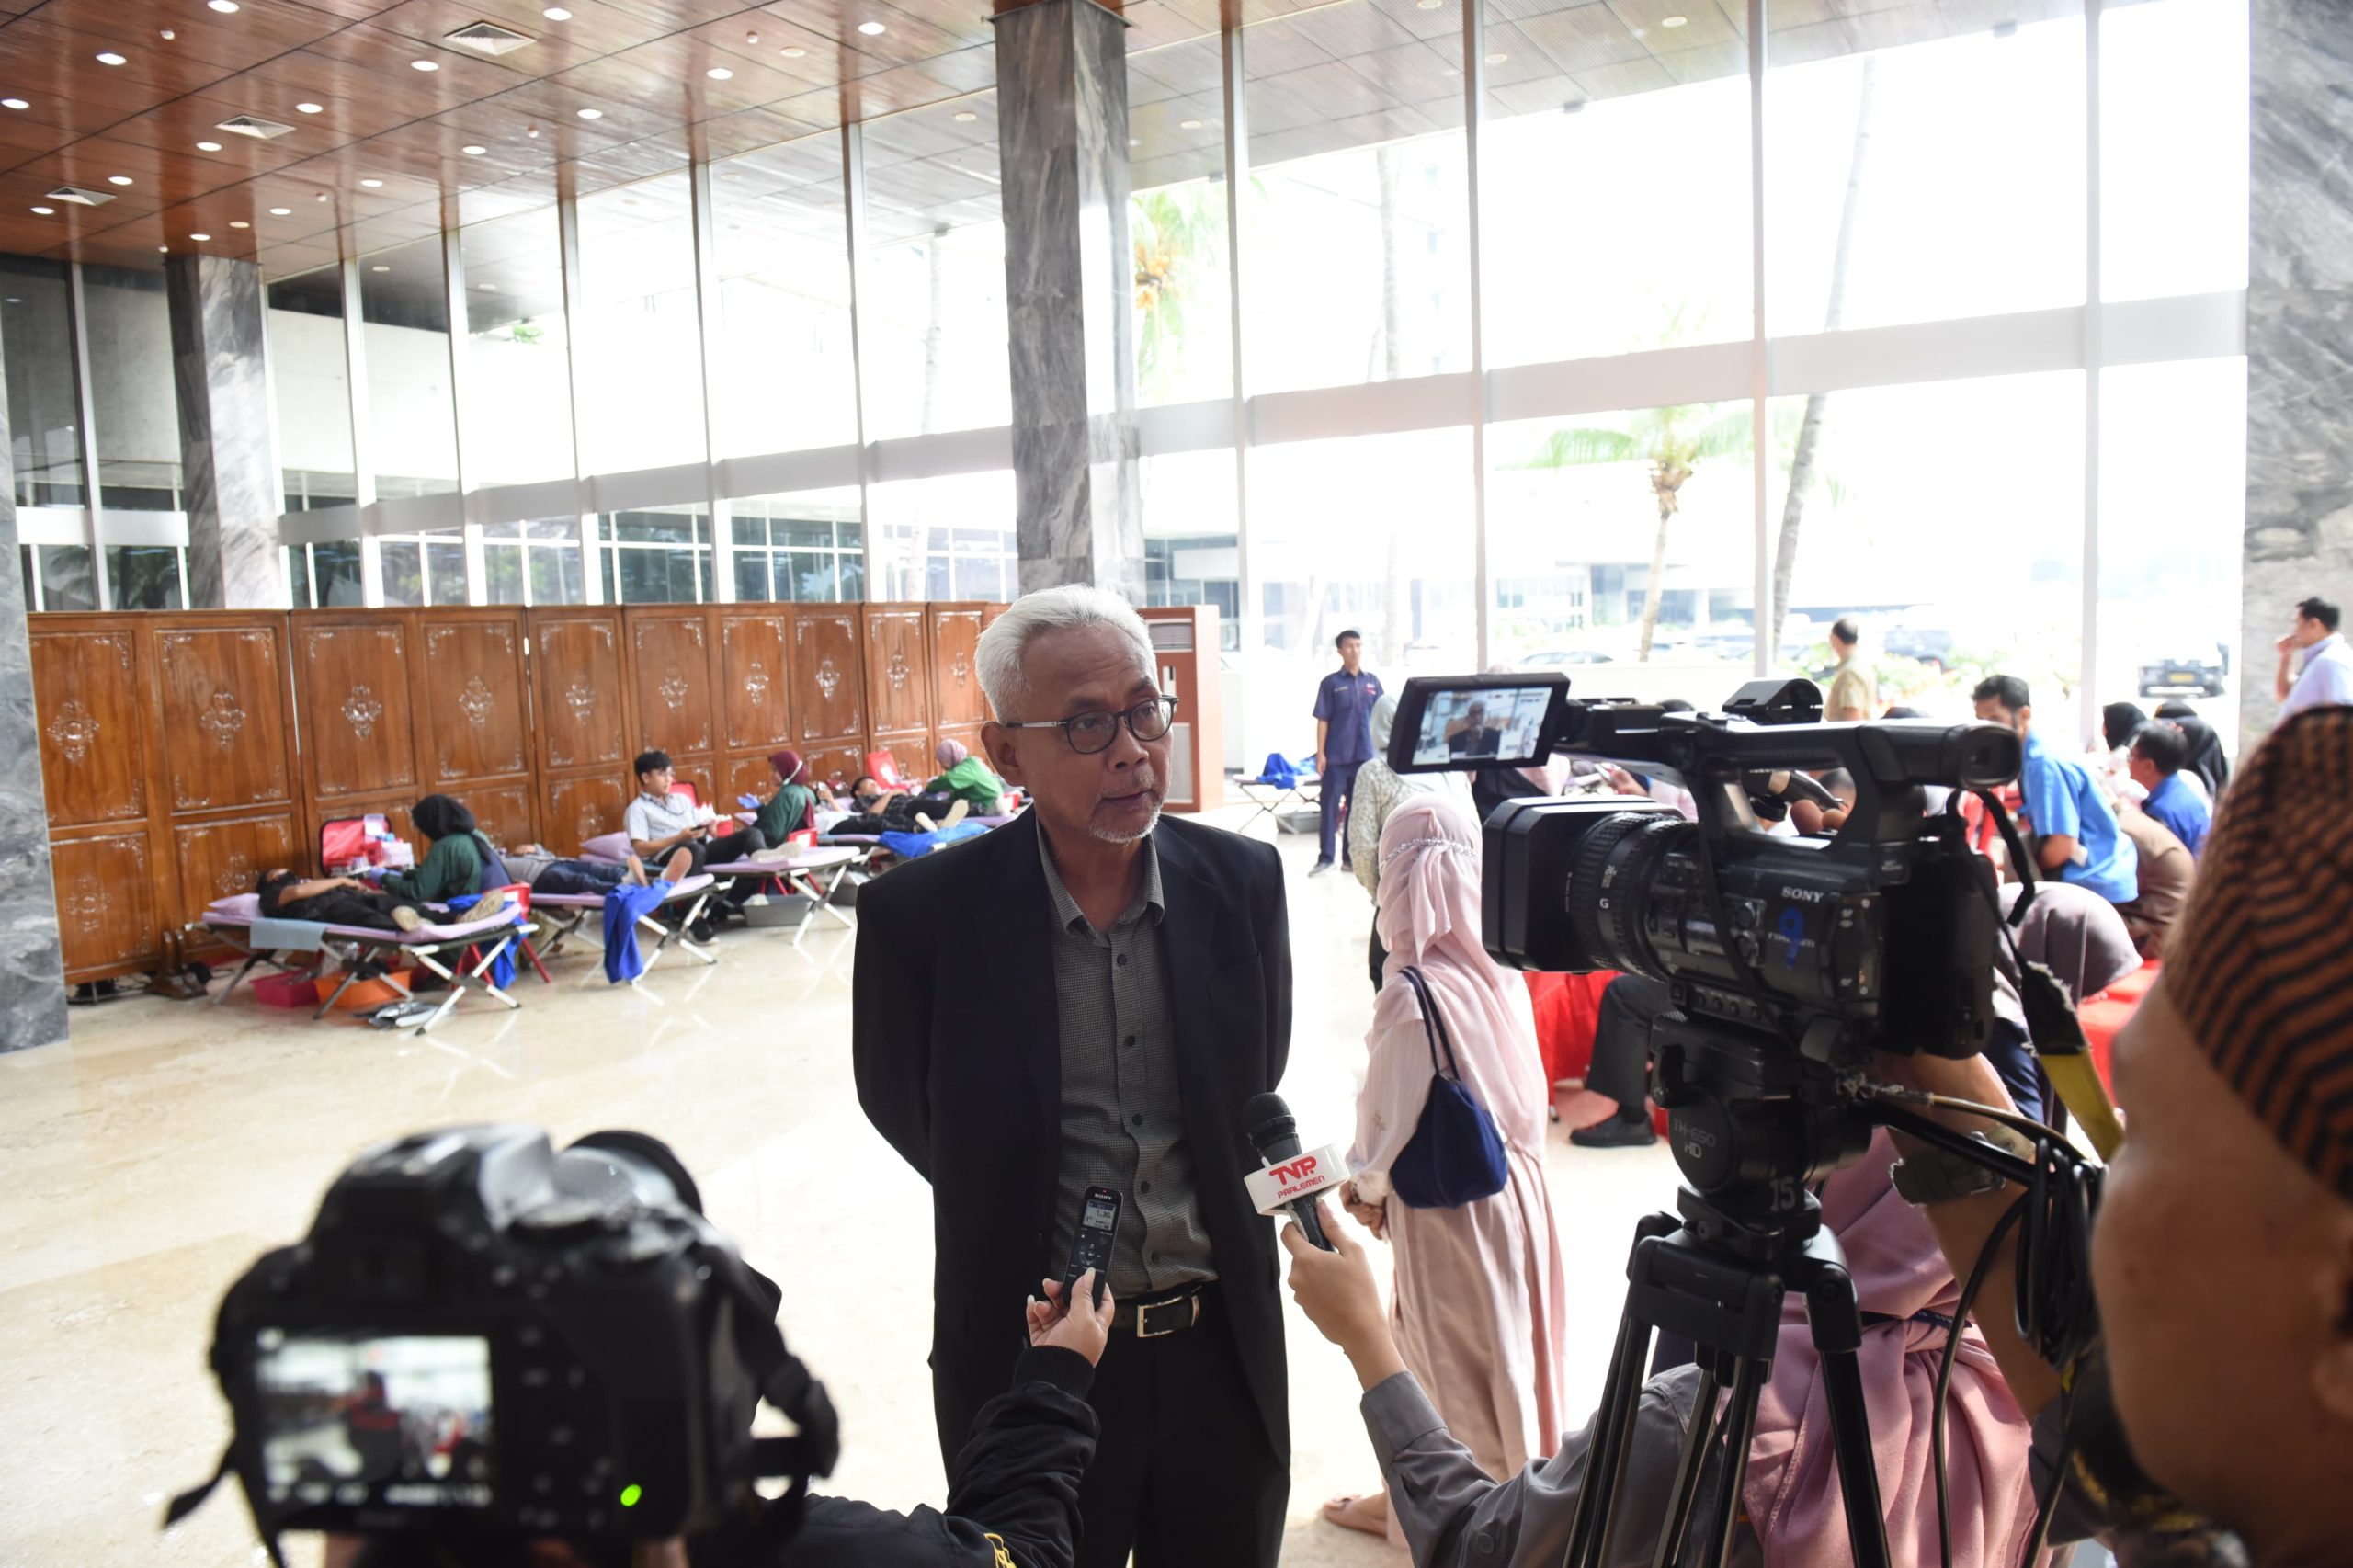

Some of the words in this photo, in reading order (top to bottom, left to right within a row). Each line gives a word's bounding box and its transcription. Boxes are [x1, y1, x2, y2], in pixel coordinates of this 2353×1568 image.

[1781, 885, 1824, 903] SONY
[1599, 897, 1609, 910] G
[1684, 1141, 1702, 1159] HD
[1277, 1174, 1325, 1199] PARLEMEN
[1769, 1175, 1796, 1212] 15
[1094, 1193, 1113, 1201] SONY
